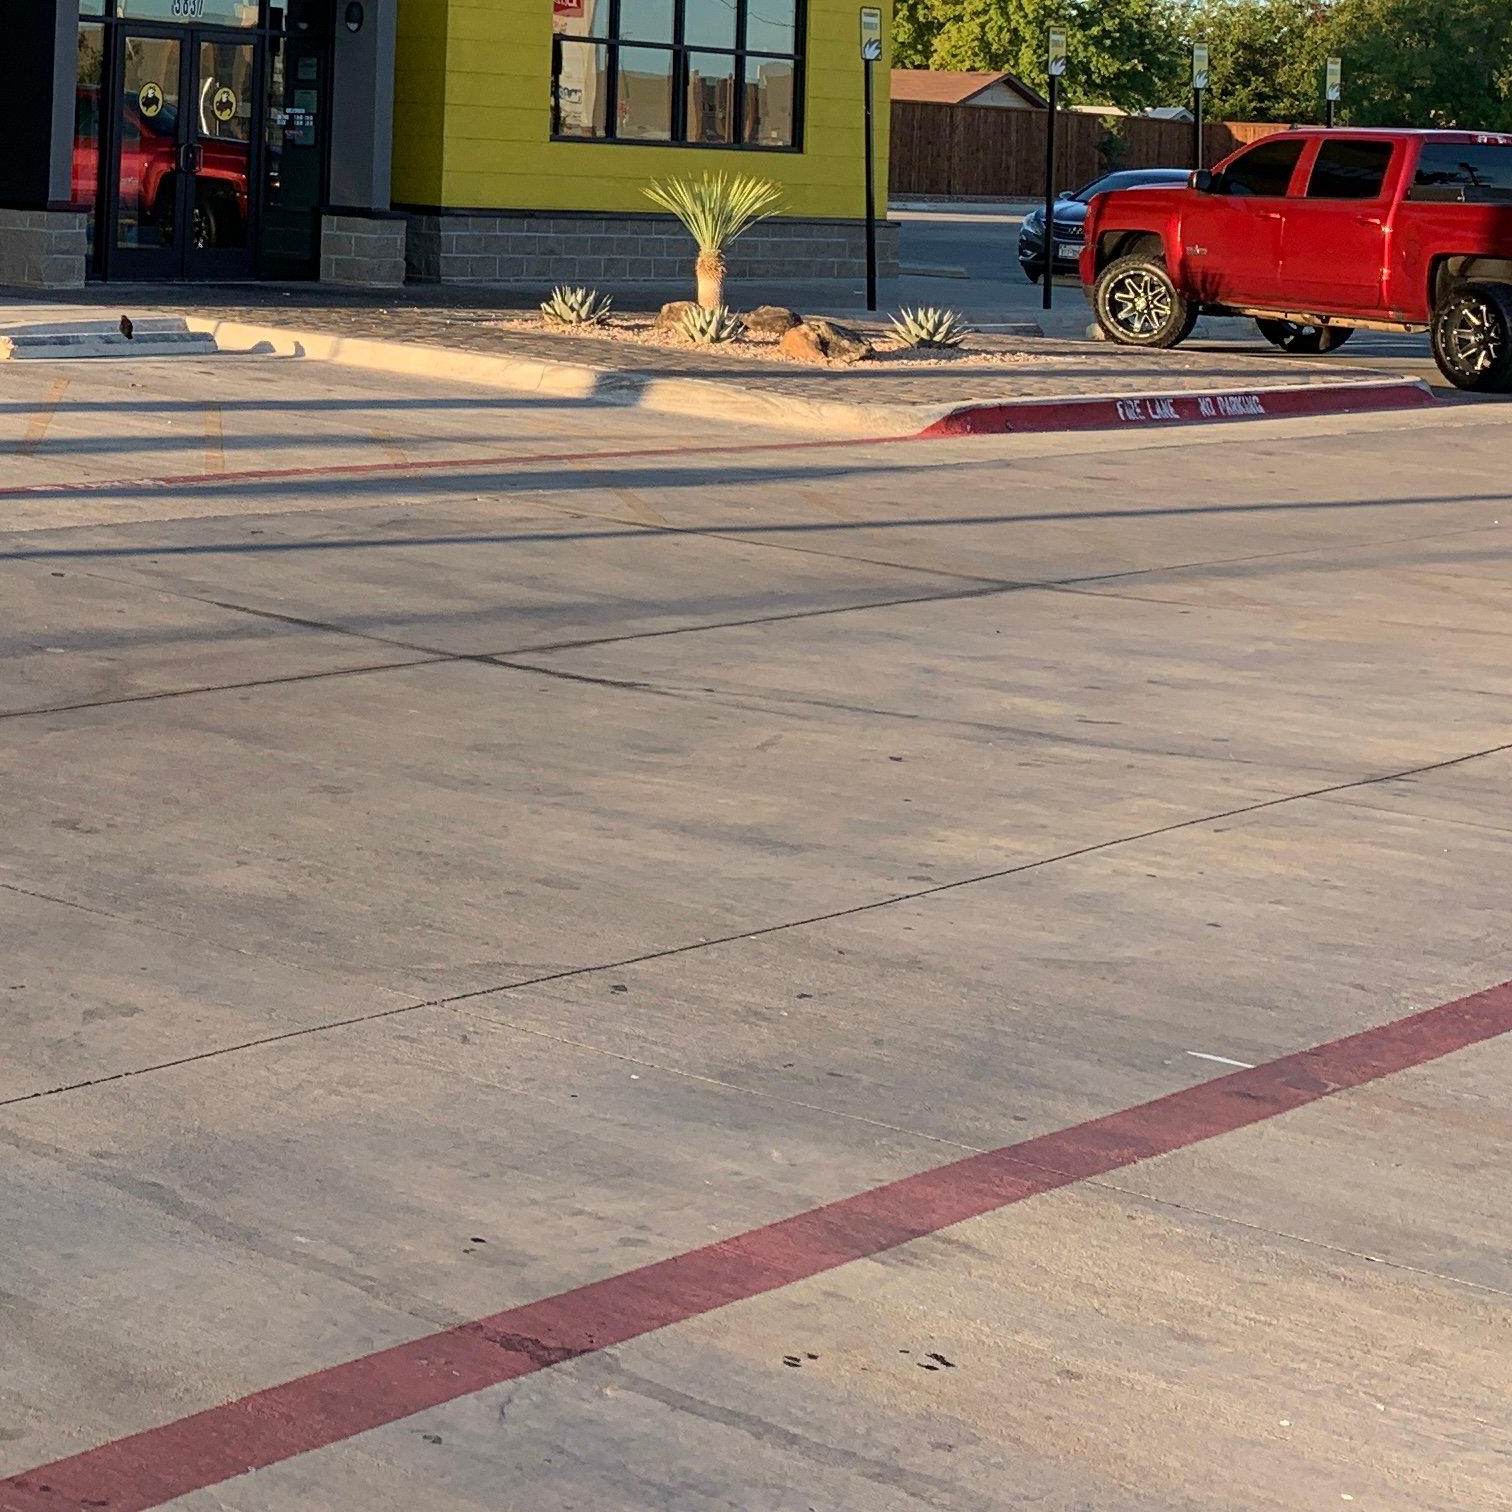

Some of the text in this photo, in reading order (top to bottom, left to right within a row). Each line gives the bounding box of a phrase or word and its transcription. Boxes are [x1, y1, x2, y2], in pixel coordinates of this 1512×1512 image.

[1116, 395, 1265, 421] FIRE LANE NO PARKING
